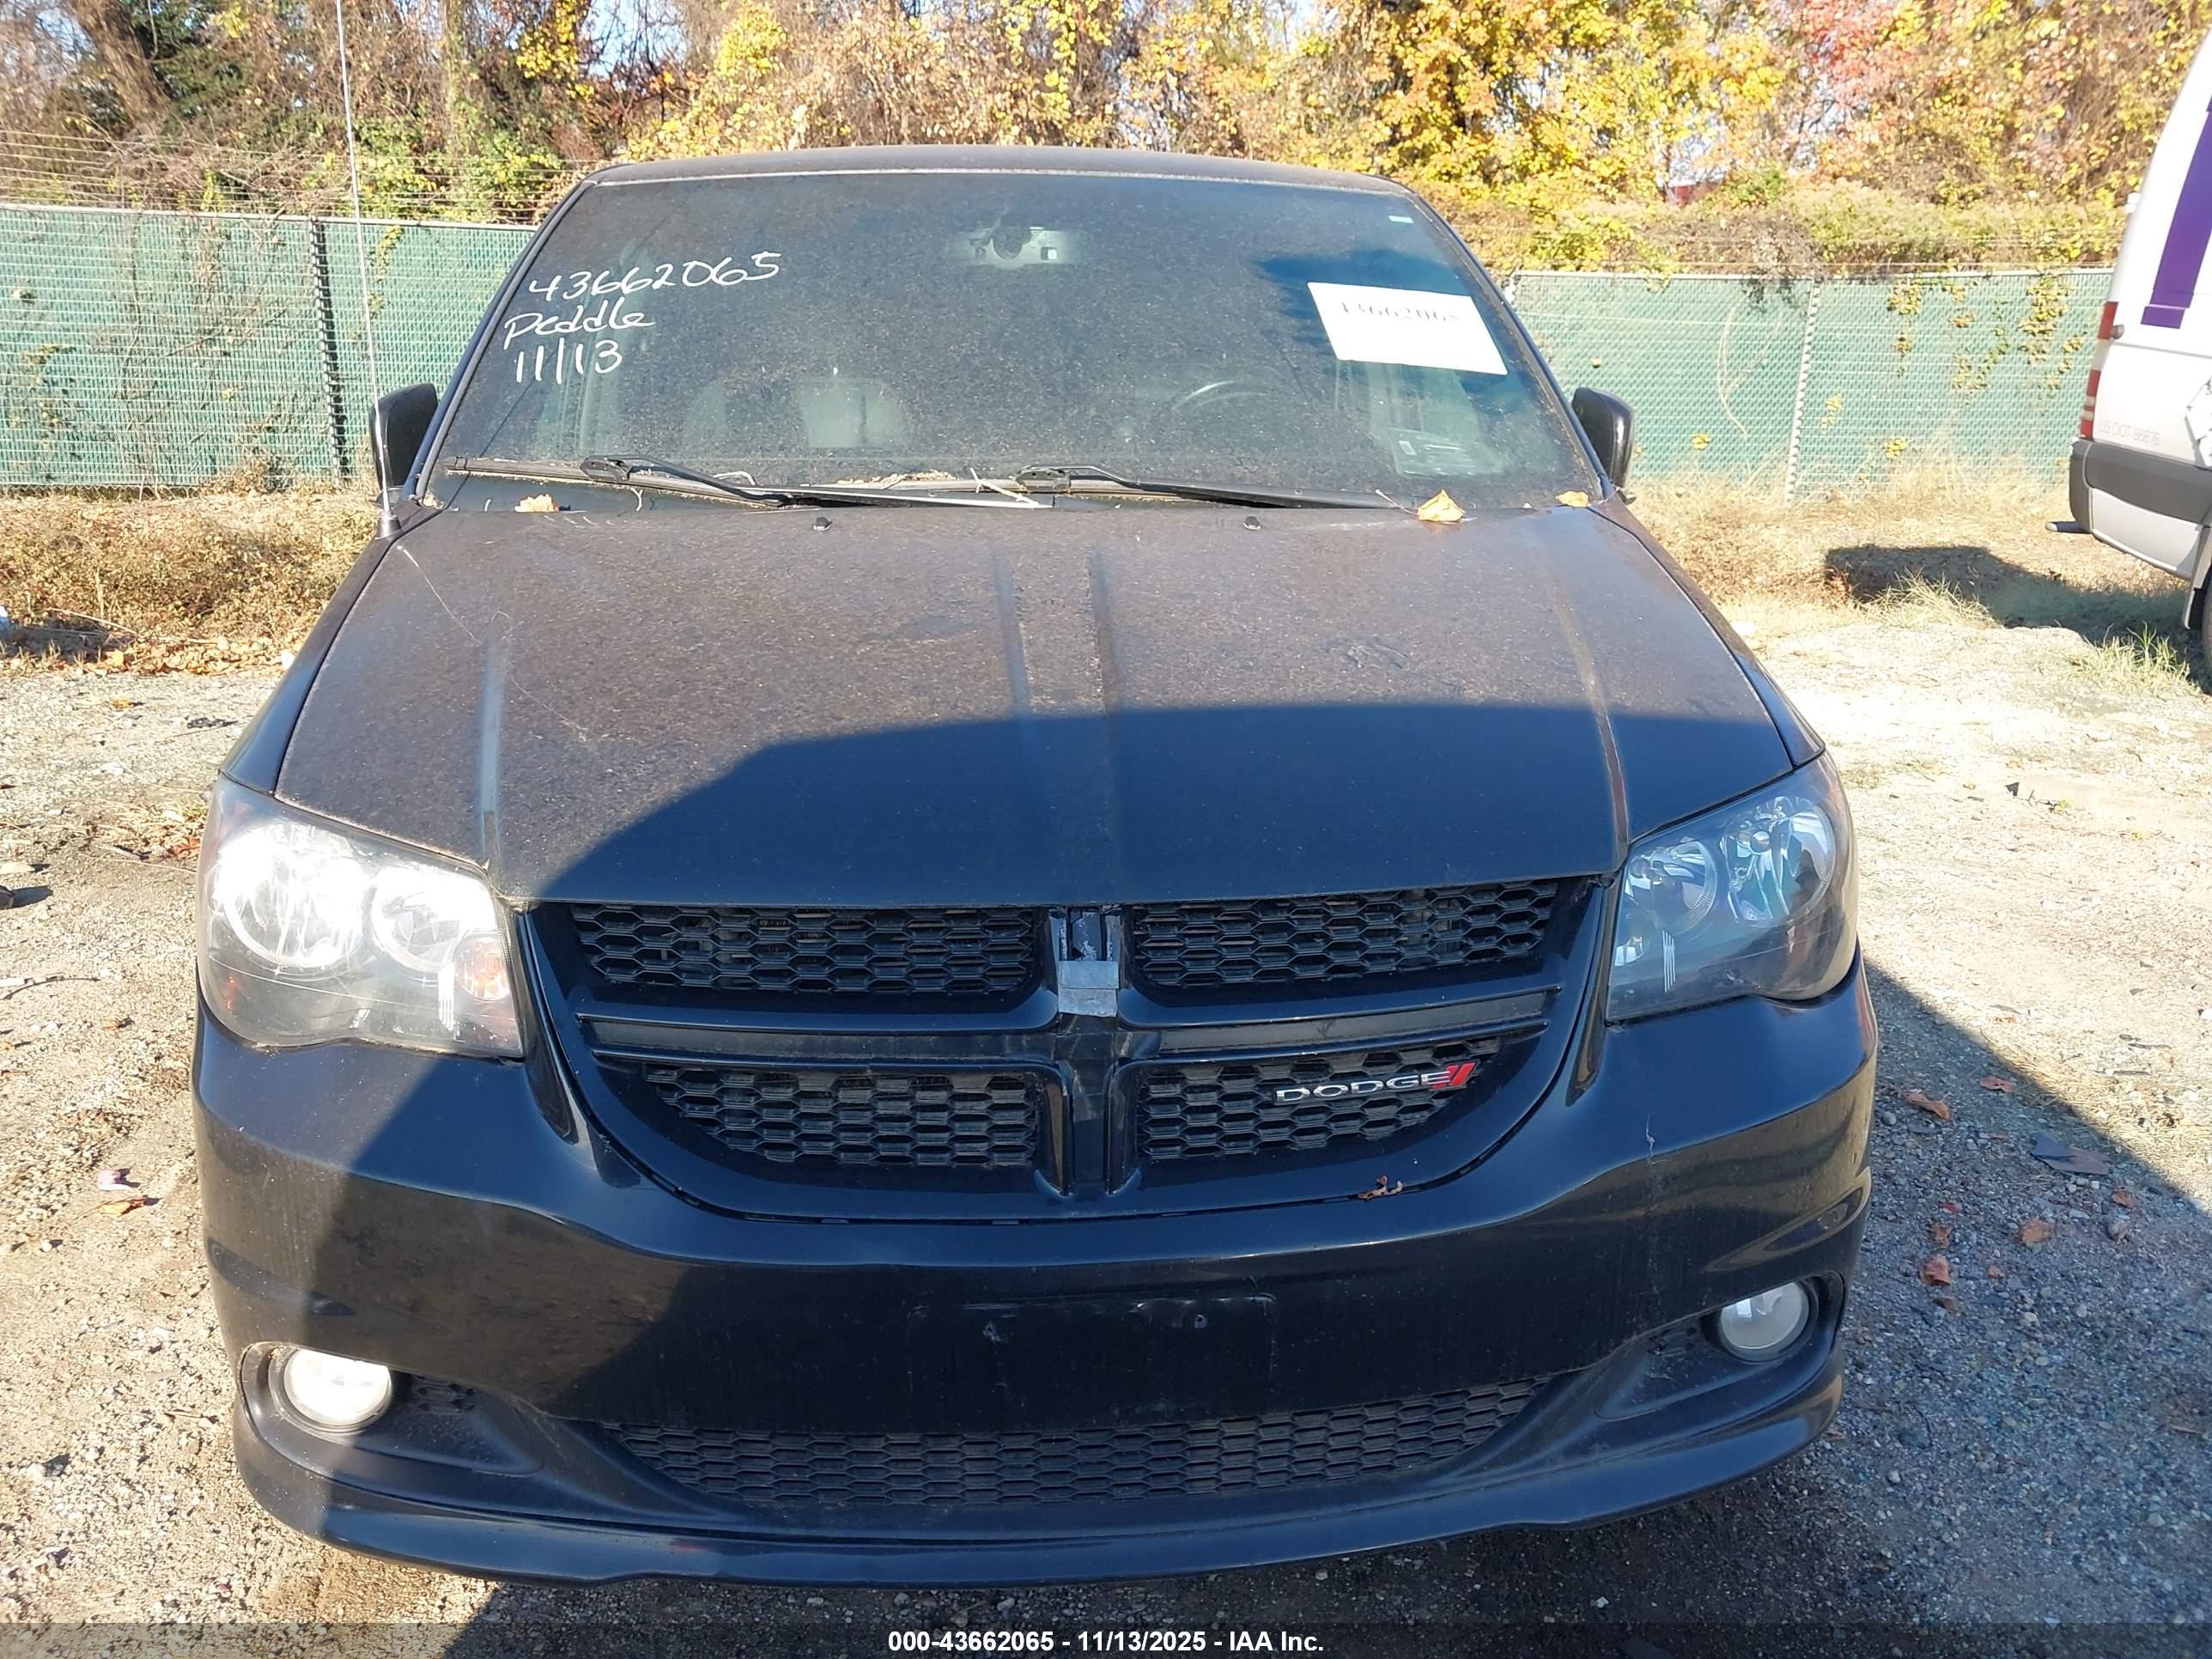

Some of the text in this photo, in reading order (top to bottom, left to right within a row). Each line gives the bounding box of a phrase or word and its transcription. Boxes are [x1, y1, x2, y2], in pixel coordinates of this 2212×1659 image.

[528, 251, 782, 301] 43662065
[503, 296, 657, 350] Peddle
[515, 337, 623, 385] 11/13
[1275, 1070, 1451, 1102] DODGE
